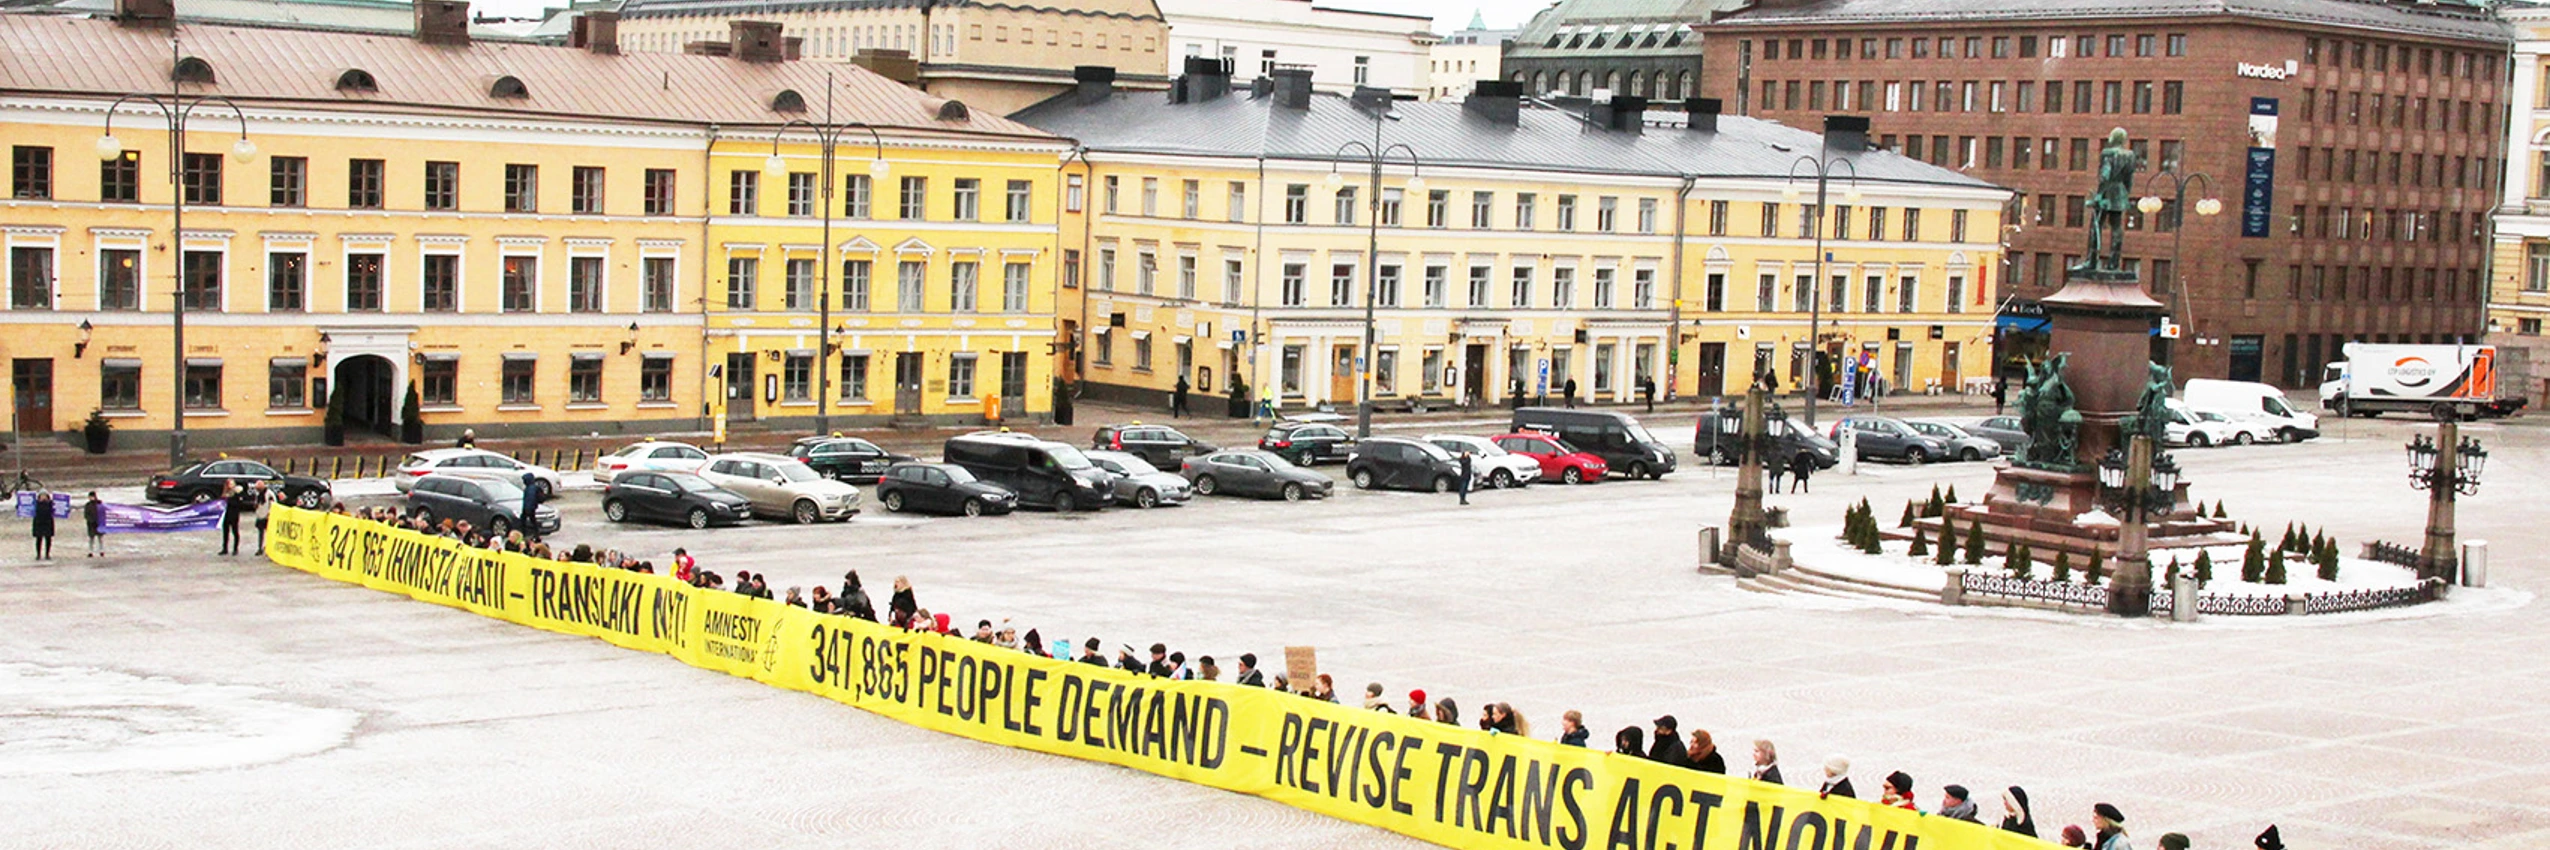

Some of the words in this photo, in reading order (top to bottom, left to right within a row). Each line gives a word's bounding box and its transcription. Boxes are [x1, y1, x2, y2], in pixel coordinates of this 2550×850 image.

[2237, 62, 2286, 80] Nordea
[1846, 358, 1855, 373] P
[531, 568, 644, 635] TRANSLAKI
[653, 587, 689, 648] NYT!
[704, 609, 761, 643] AMNESTY
[810, 624, 909, 704] 347,865
[918, 645, 1047, 736] PEOPLE
[1057, 674, 1229, 770] DEMAND
[1275, 711, 1423, 816] REVISE
[1434, 742, 1594, 850] TRANS
[1606, 777, 1724, 850] ACT
